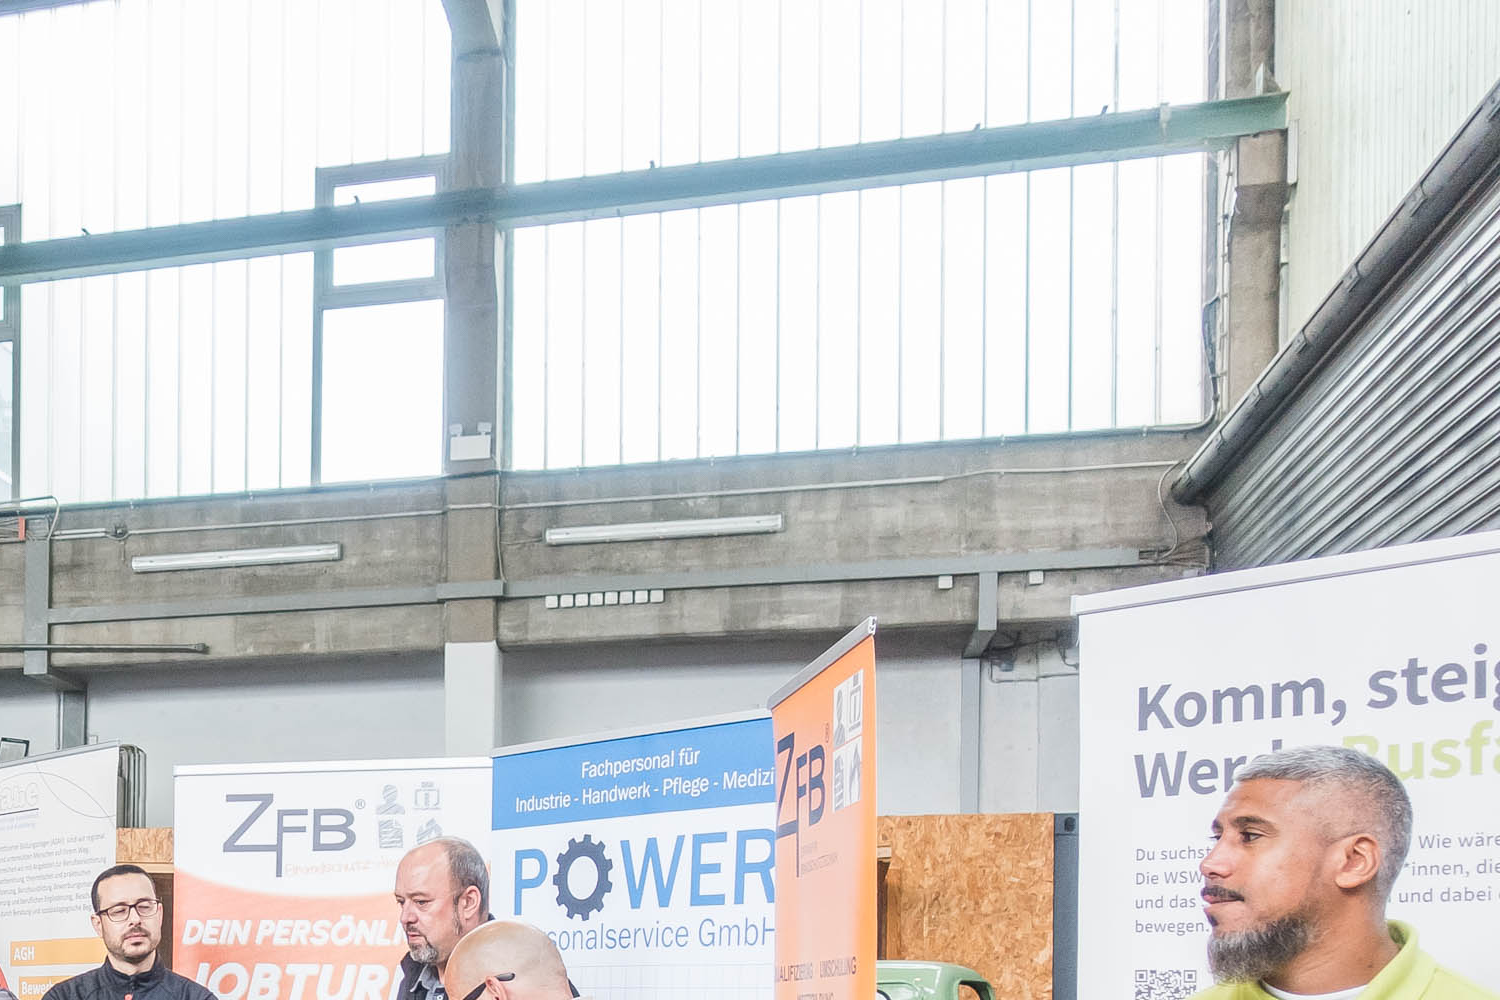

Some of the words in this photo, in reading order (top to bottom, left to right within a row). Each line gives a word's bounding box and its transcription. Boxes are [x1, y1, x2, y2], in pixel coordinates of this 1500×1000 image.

[1138, 677, 1347, 731] Komm,
[581, 750, 675, 779] Fachpersonal
[678, 747, 701, 766] für
[1134, 739, 1283, 798] Wer
[516, 791, 571, 813] Industrie
[582, 782, 651, 805] Handwerk
[663, 776, 709, 798] Pflege
[723, 766, 775, 790] Medizi
[776, 732, 825, 878] ZFB
[1418, 833, 1452, 849] Wie
[1135, 848, 1155, 861] Du
[1160, 845, 1212, 861] suchst
[514, 829, 776, 922] POWER
[1135, 871, 1159, 885] Die
[1164, 871, 1202, 884] WSW
[1135, 896, 1164, 909] und
[1169, 894, 1197, 909] das
[1399, 887, 1433, 903] und
[1440, 886, 1492, 902] dabei
[182, 919, 250, 945] DEIN
[1135, 920, 1210, 936] bewegen.
[14, 946, 35, 961] AGH
